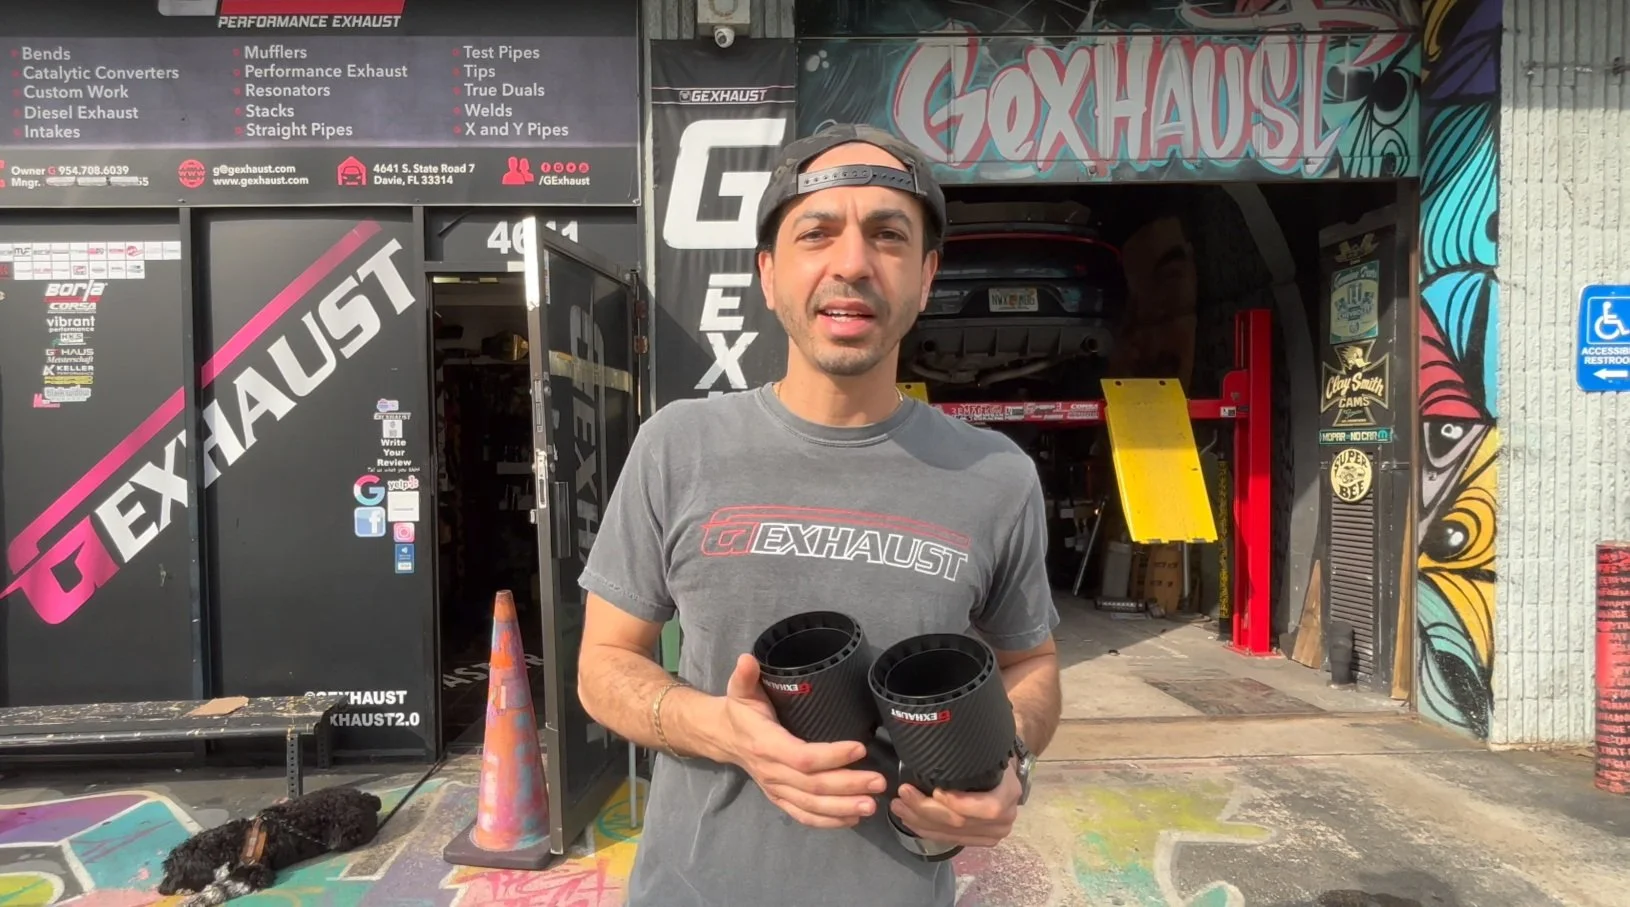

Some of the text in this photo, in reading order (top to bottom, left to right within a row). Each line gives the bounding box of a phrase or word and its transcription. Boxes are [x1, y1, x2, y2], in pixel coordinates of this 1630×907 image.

[218, 15, 402, 28] PERFORMANCE EXHAUST
[22, 46, 71, 61] Bends
[244, 45, 307, 59] Mufflers
[463, 46, 540, 62] Test Pipes
[23, 66, 180, 82] Catalytic Converters
[244, 64, 408, 79] Performance Exhaust
[464, 65, 496, 81] Tips
[24, 85, 129, 99] Custom Work
[245, 84, 331, 98] Resonators
[464, 83, 545, 98] True Duals
[691, 89, 767, 102] GEXHAUST
[24, 106, 139, 120] Diesel Exhaust
[245, 104, 295, 118] Stacks
[465, 103, 513, 117] Welds
[24, 125, 81, 139] Intakes
[246, 122, 353, 140] Straight Pipes
[465, 122, 569, 139] X and Y Pipes
[11, 167, 46, 176] Owner
[58, 165, 130, 176] 954.708.6039
[213, 165, 296, 176] g@gexhaust.com
[373, 163, 475, 174] 4641 S. State Road 7
[11, 178, 41, 190] Mngr.
[213, 176, 309, 188] www.gexhaust.com
[374, 175, 454, 187] Davie, FL 33314
[539, 175, 591, 187] /GExhaust
[487, 221, 579, 254] 461
[46, 316, 96, 327] vibrant
[1584, 356, 1630, 364] RESTROO
[1326, 372, 1384, 399] Clay Smith
[1339, 397, 1370, 408] CAMS
[381, 439, 407, 447] Write
[1322, 432, 1346, 442] MOPAR
[1351, 431, 1361, 441] NO
[1362, 431, 1378, 441] CAR
[1333, 450, 1368, 470] SUPER
[1339, 481, 1365, 500] BEE
[890, 708, 952, 724] GEXHAUST
